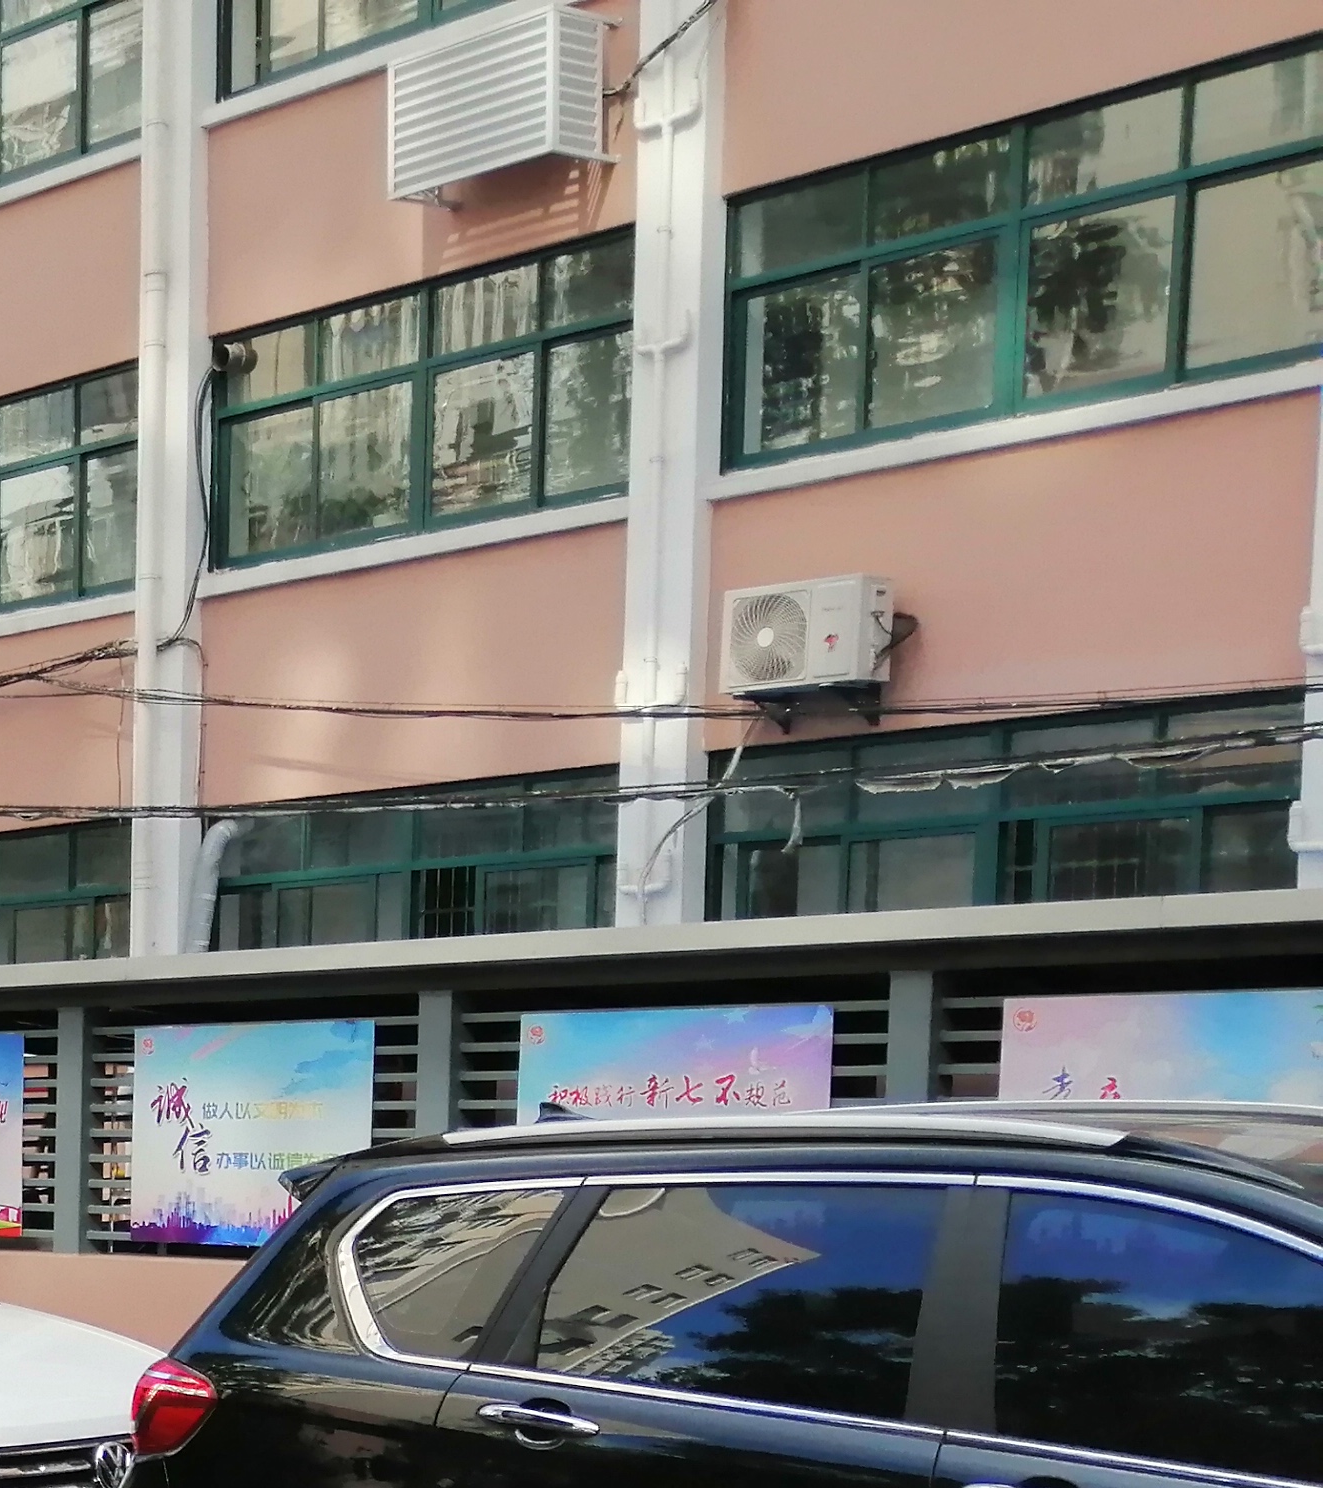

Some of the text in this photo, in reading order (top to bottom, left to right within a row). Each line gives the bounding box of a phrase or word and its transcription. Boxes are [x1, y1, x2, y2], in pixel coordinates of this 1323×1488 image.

[216, 1151, 339, 1171] 办事以诚信为
